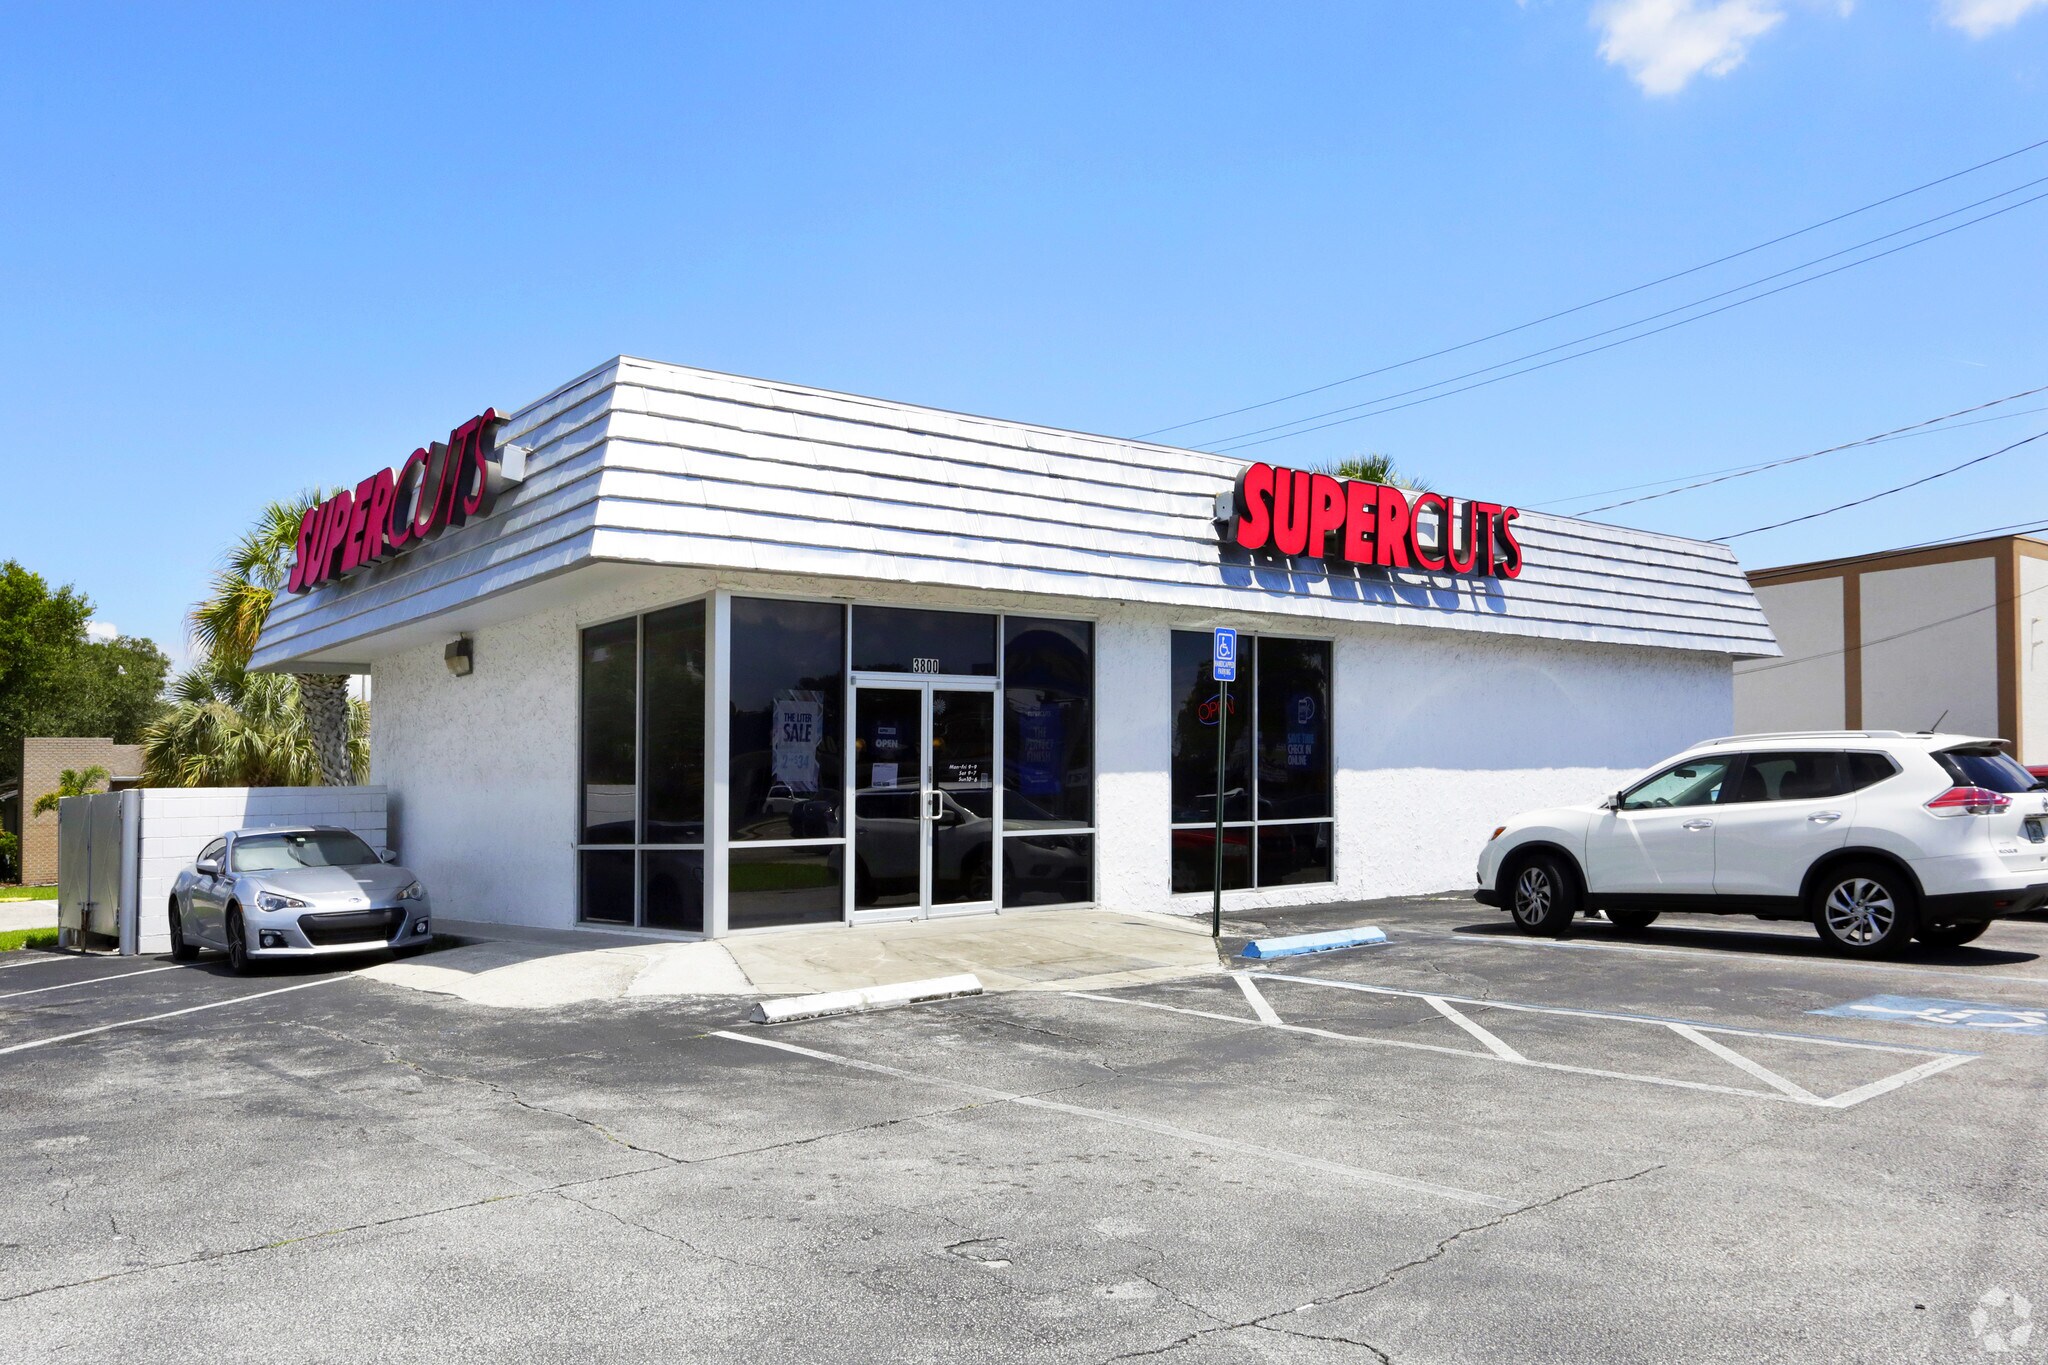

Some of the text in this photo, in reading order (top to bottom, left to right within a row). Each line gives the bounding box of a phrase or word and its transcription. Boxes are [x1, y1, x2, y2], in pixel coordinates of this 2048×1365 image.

[288, 407, 497, 594] SUPERCUTS
[1235, 462, 1523, 579] SUPERCUTS
[914, 658, 938, 673] 3800
[784, 712, 813, 723] THE LITER
[783, 723, 812, 743] SALE
[875, 738, 898, 748] OPEN
